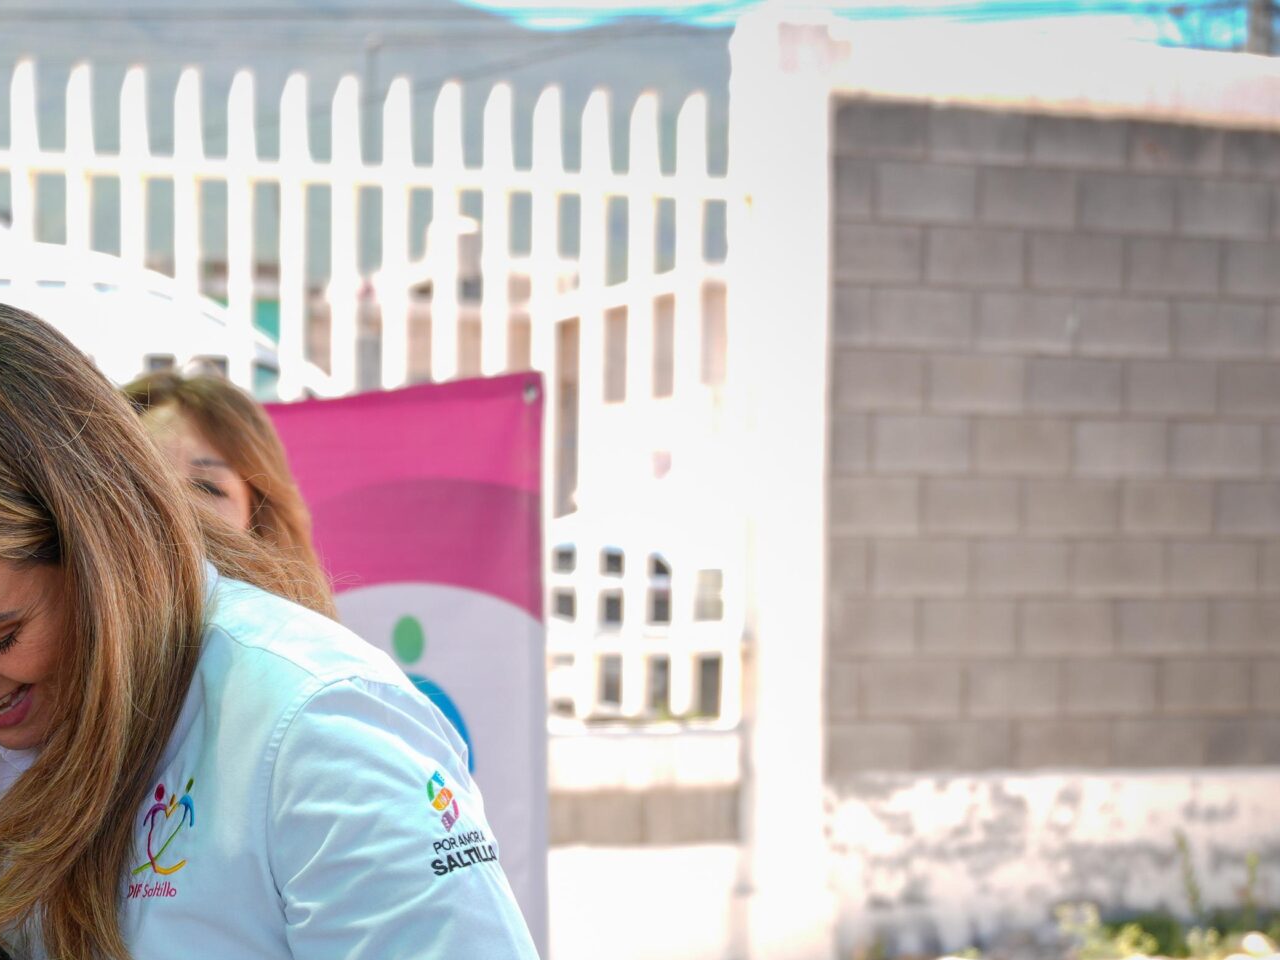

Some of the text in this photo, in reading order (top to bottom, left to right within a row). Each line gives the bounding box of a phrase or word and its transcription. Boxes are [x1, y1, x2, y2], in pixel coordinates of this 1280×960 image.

[433, 837, 459, 854] POR
[458, 831, 481, 847] AMOR
[127, 881, 177, 898] DIF Saltillo
